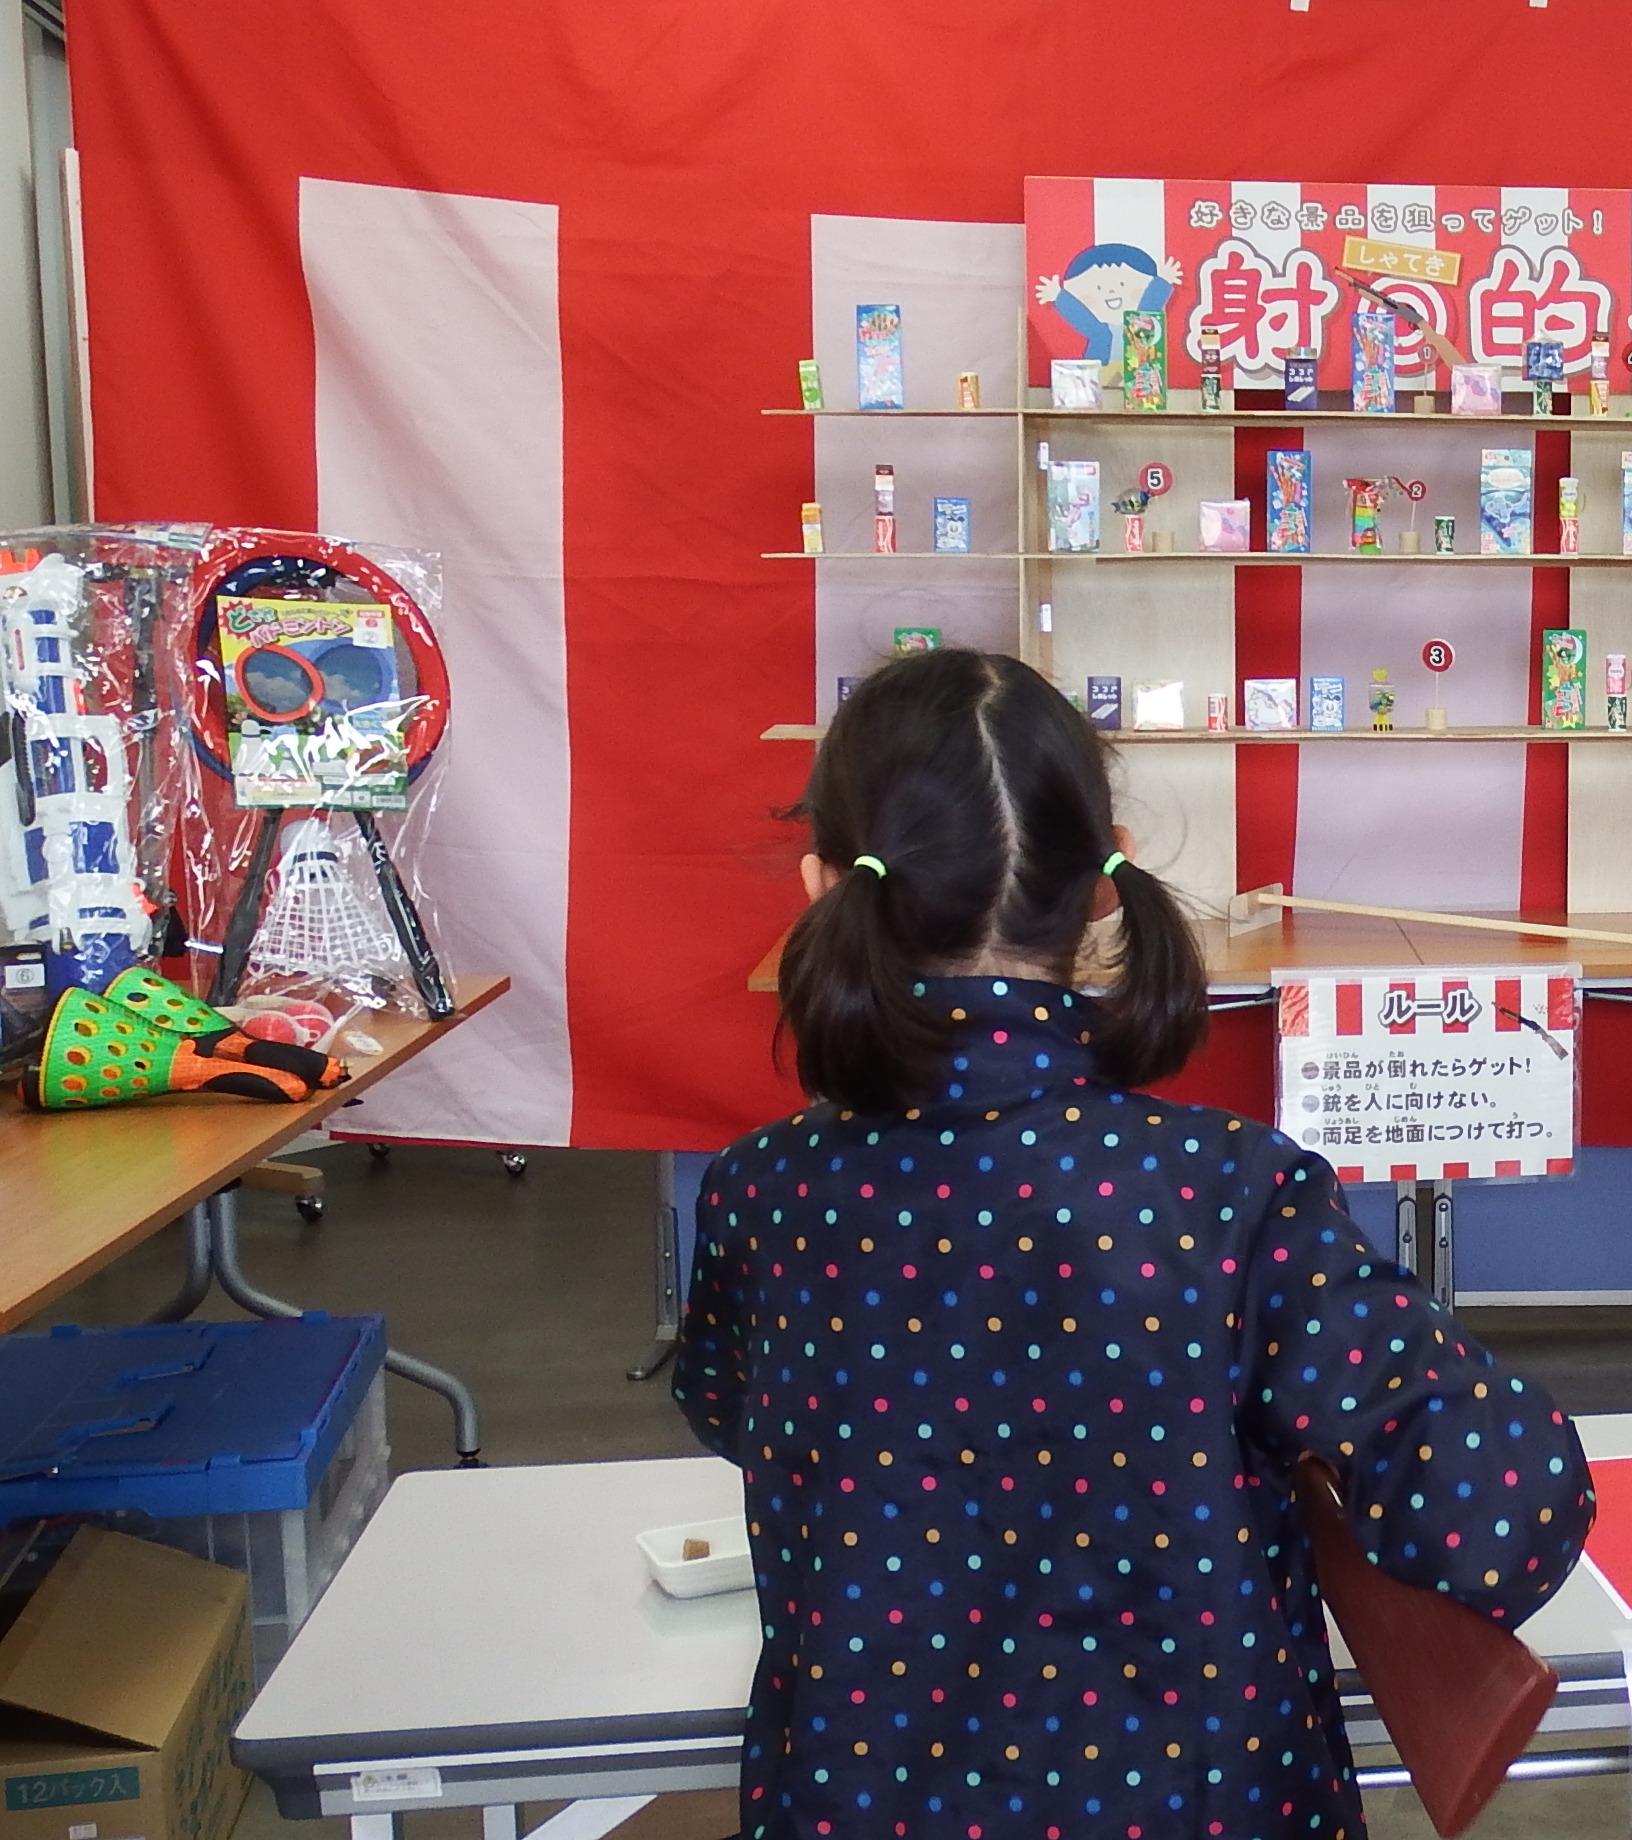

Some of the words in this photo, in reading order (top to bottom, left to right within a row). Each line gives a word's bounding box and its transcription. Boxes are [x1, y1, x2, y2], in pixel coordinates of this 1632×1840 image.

[1190, 200, 1604, 235] 好きな景品を狙ってゲット!
[1359, 245, 1444, 276] しゃてき
[1431, 647, 1443, 664] 3
[1380, 989, 1480, 1024] ルール
[1322, 1056, 1531, 1080] 景品が倒れたらゲット!
[1322, 1091, 1497, 1113] 銃を人に向けない。
[1322, 1121, 1553, 1146] 両足を地面につけて打つ。
[17, 1772, 127, 1804] 12パック入
